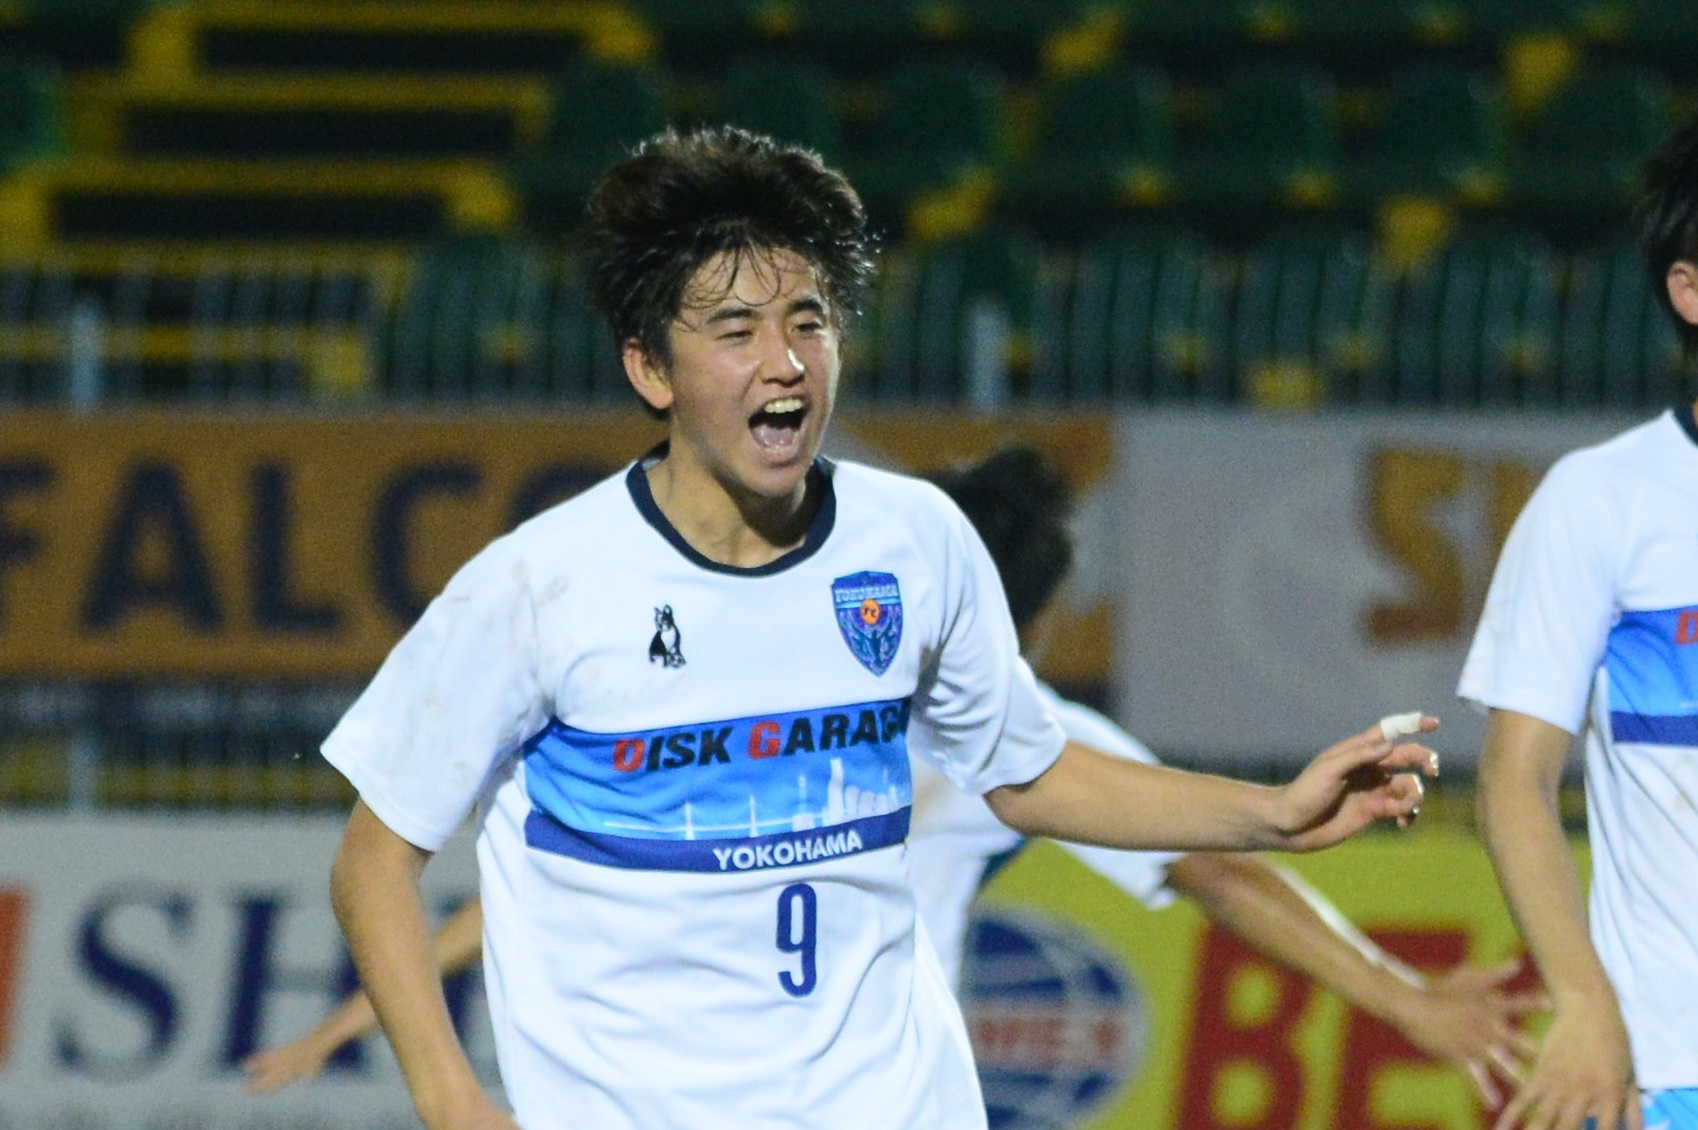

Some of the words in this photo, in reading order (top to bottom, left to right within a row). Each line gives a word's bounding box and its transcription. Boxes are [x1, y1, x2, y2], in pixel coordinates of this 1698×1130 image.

[612, 726, 735, 772] DISK
[747, 705, 905, 761] GARAG
[712, 829, 864, 871] YOKOHAMA
[774, 883, 819, 999] 9
